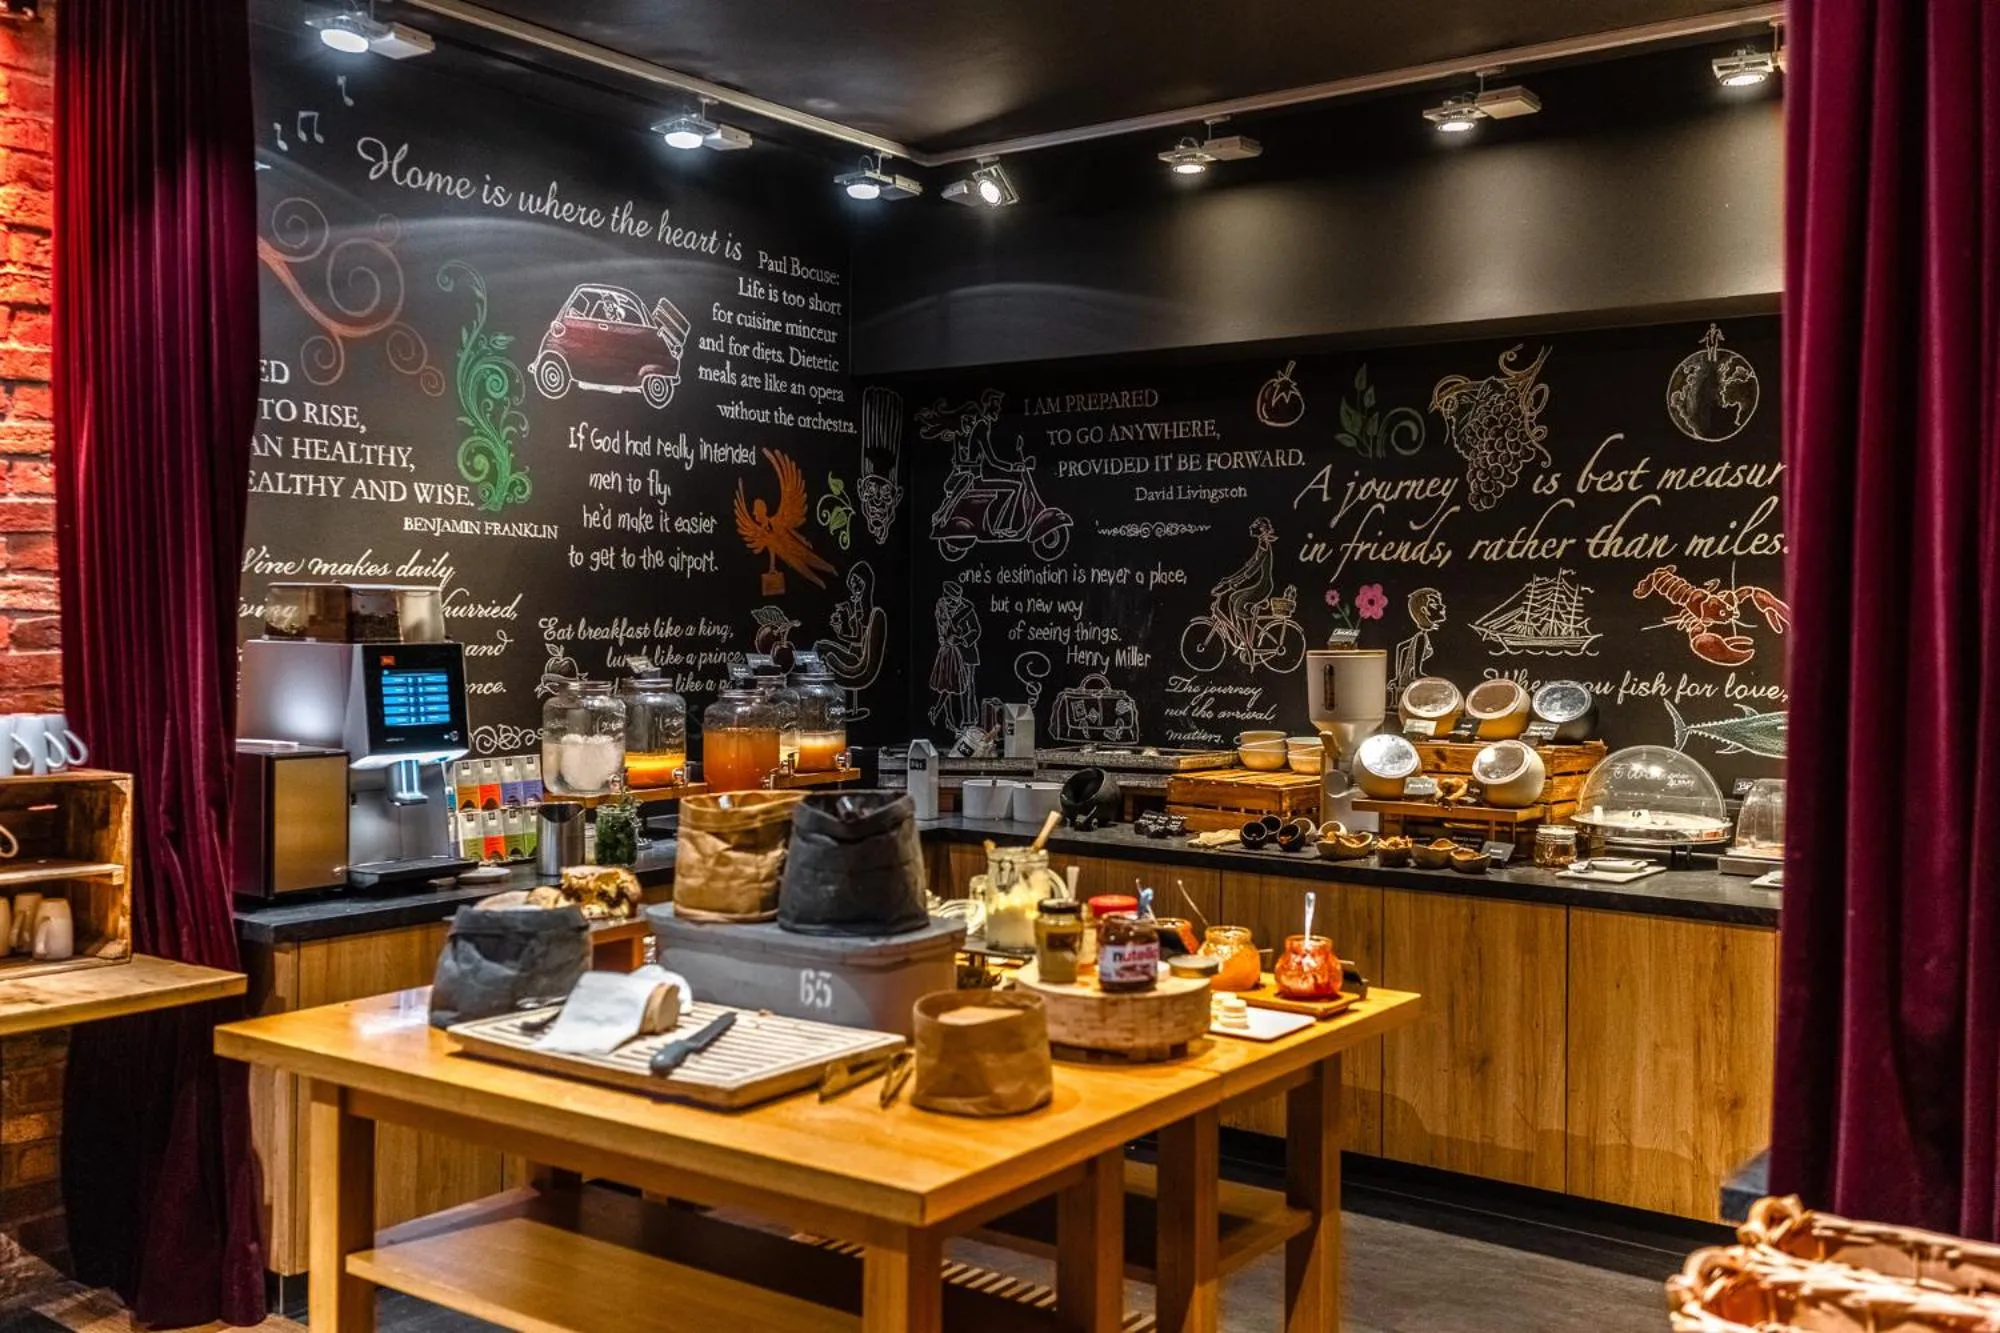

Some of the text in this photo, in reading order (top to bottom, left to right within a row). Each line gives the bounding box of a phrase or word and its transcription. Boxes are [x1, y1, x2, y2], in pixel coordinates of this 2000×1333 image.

[357, 136, 743, 261] Home is where the heart is
[758, 250, 840, 286] Paul Bocuse:
[737, 276, 842, 315] Life is too short
[712, 302, 838, 343] for cuisine minceur
[699, 334, 839, 372] and for diets. Dietetic
[698, 360, 845, 404] meals are like an opera
[258, 398, 367, 433] TO RISE,
[716, 401, 858, 434] without the orchestra.
[1024, 388, 1160, 416] I AM PREPARED
[568, 422, 756, 470] If God had really intended
[1046, 418, 1221, 447] TO GO ANYWHERE,
[292, 436, 416, 473] HEALTHY,
[1057, 448, 1306, 479] PROVIDED IT BE FORWARD.
[351, 477, 407, 503] AND
[413, 482, 475, 508] WISE.
[589, 470, 622, 493] men
[626, 473, 642, 495] to
[1135, 484, 1249, 504] David Livingston
[1293, 463, 1332, 510] A
[1329, 469, 1459, 530] journey
[1532, 472, 1562, 495] is
[1576, 432, 1651, 494] best
[403, 517, 559, 541] BENJAMIN FRANKLIN
[583, 503, 718, 535] he'd make it easier
[1299, 494, 1789, 583] in friends, rather than miles.
[307, 548, 391, 577] makes
[395, 548, 455, 588] daily
[568, 545, 719, 578] to get to the airport.
[958, 561, 1187, 591] one's destination is never a place,
[990, 594, 1083, 621] but a new way
[464, 629, 514, 657] and
[538, 616, 735, 647] Eat breakfast like a king,
[1008, 619, 1122, 645] of seeing things.
[654, 644, 687, 665] like
[686, 652, 699, 664] a
[1066, 644, 1151, 675] Henry Miller
[675, 672, 705, 693] like
[706, 679, 717, 692] a
[1164, 675, 1201, 693] The
[1617, 670, 1671, 704] fish
[1675, 673, 1719, 703] for
[1724, 672, 1790, 703] love,
[1164, 704, 1190, 716] not
[1191, 697, 1216, 719] the
[801, 968, 832, 1008] 65
